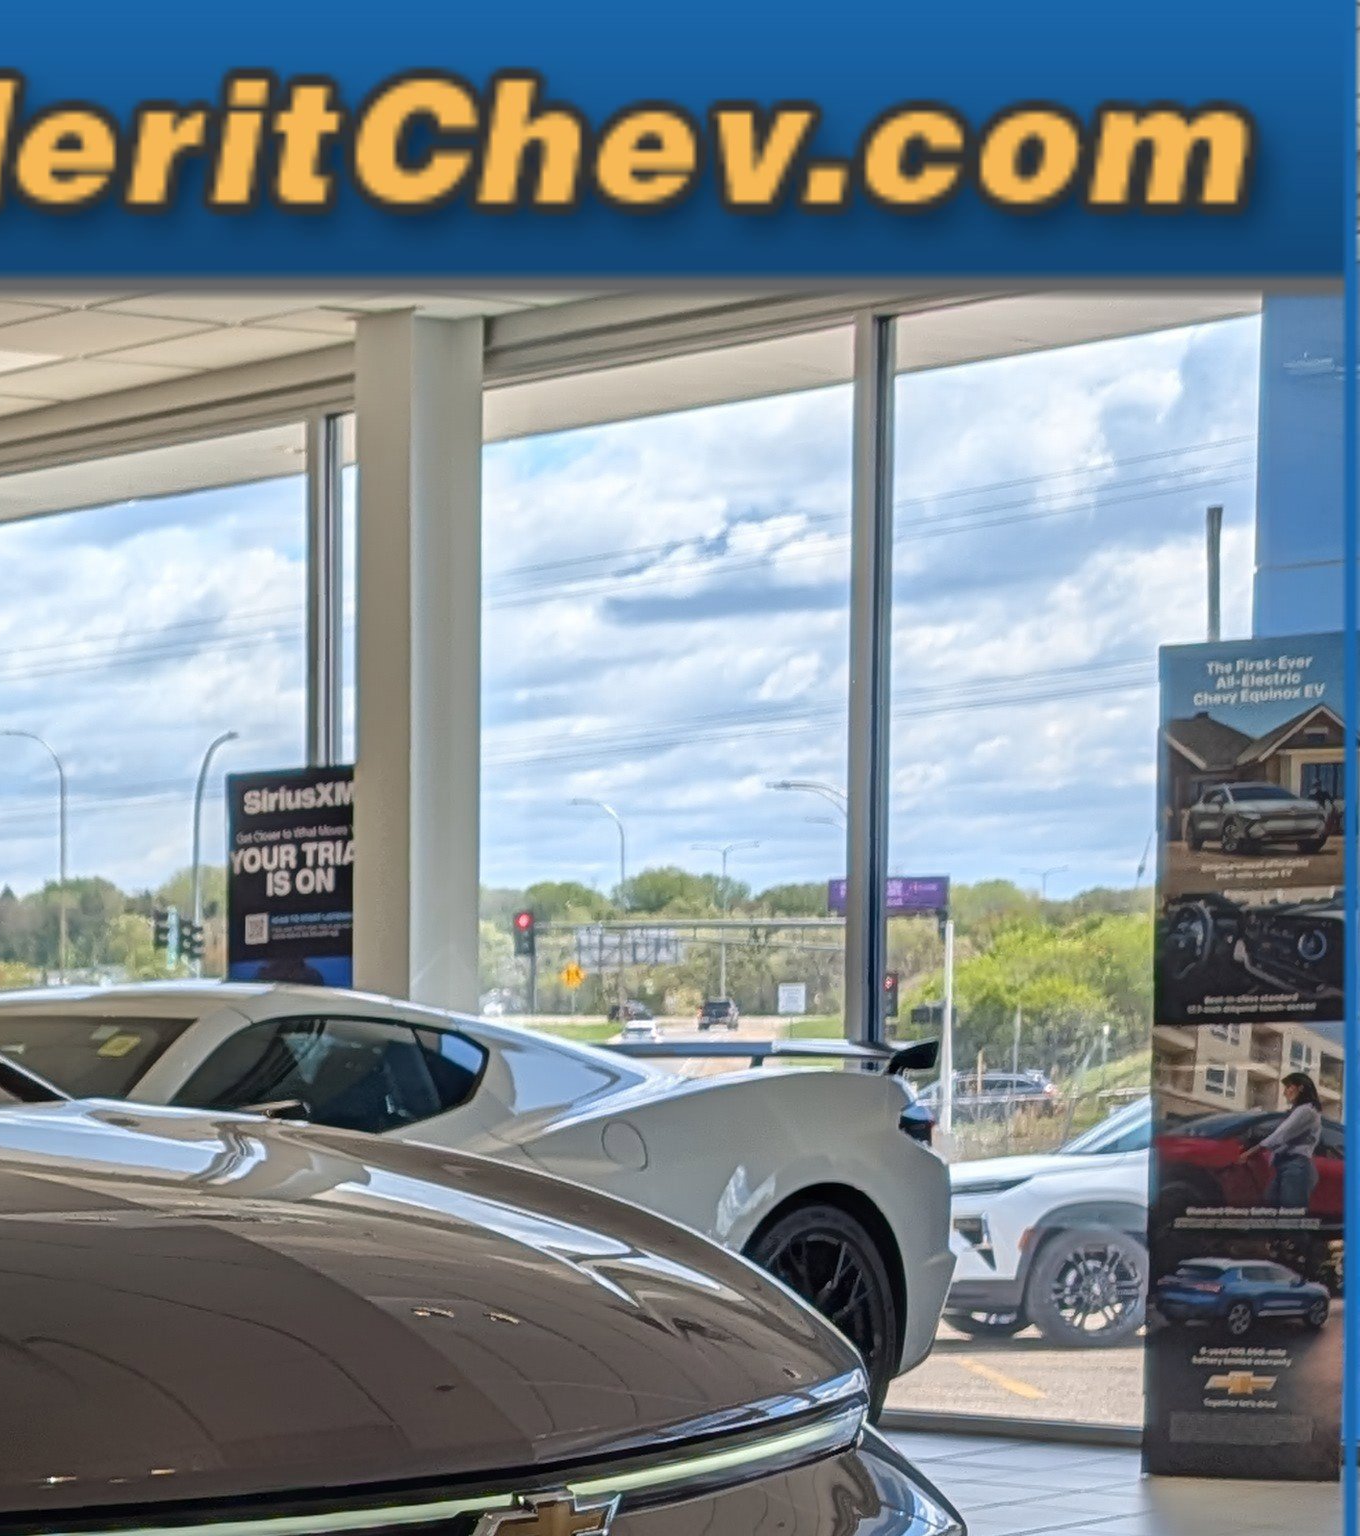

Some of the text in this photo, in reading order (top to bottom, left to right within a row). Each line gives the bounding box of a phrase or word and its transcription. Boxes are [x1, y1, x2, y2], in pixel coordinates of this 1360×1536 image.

[1206, 655, 1314, 676] The First-Ever
[1215, 672, 1301, 690] All-Electric
[1193, 682, 1326, 706] Chevy Equinox EV
[230, 839, 355, 875] YOUR TRIA
[266, 867, 335, 897] IS ON
